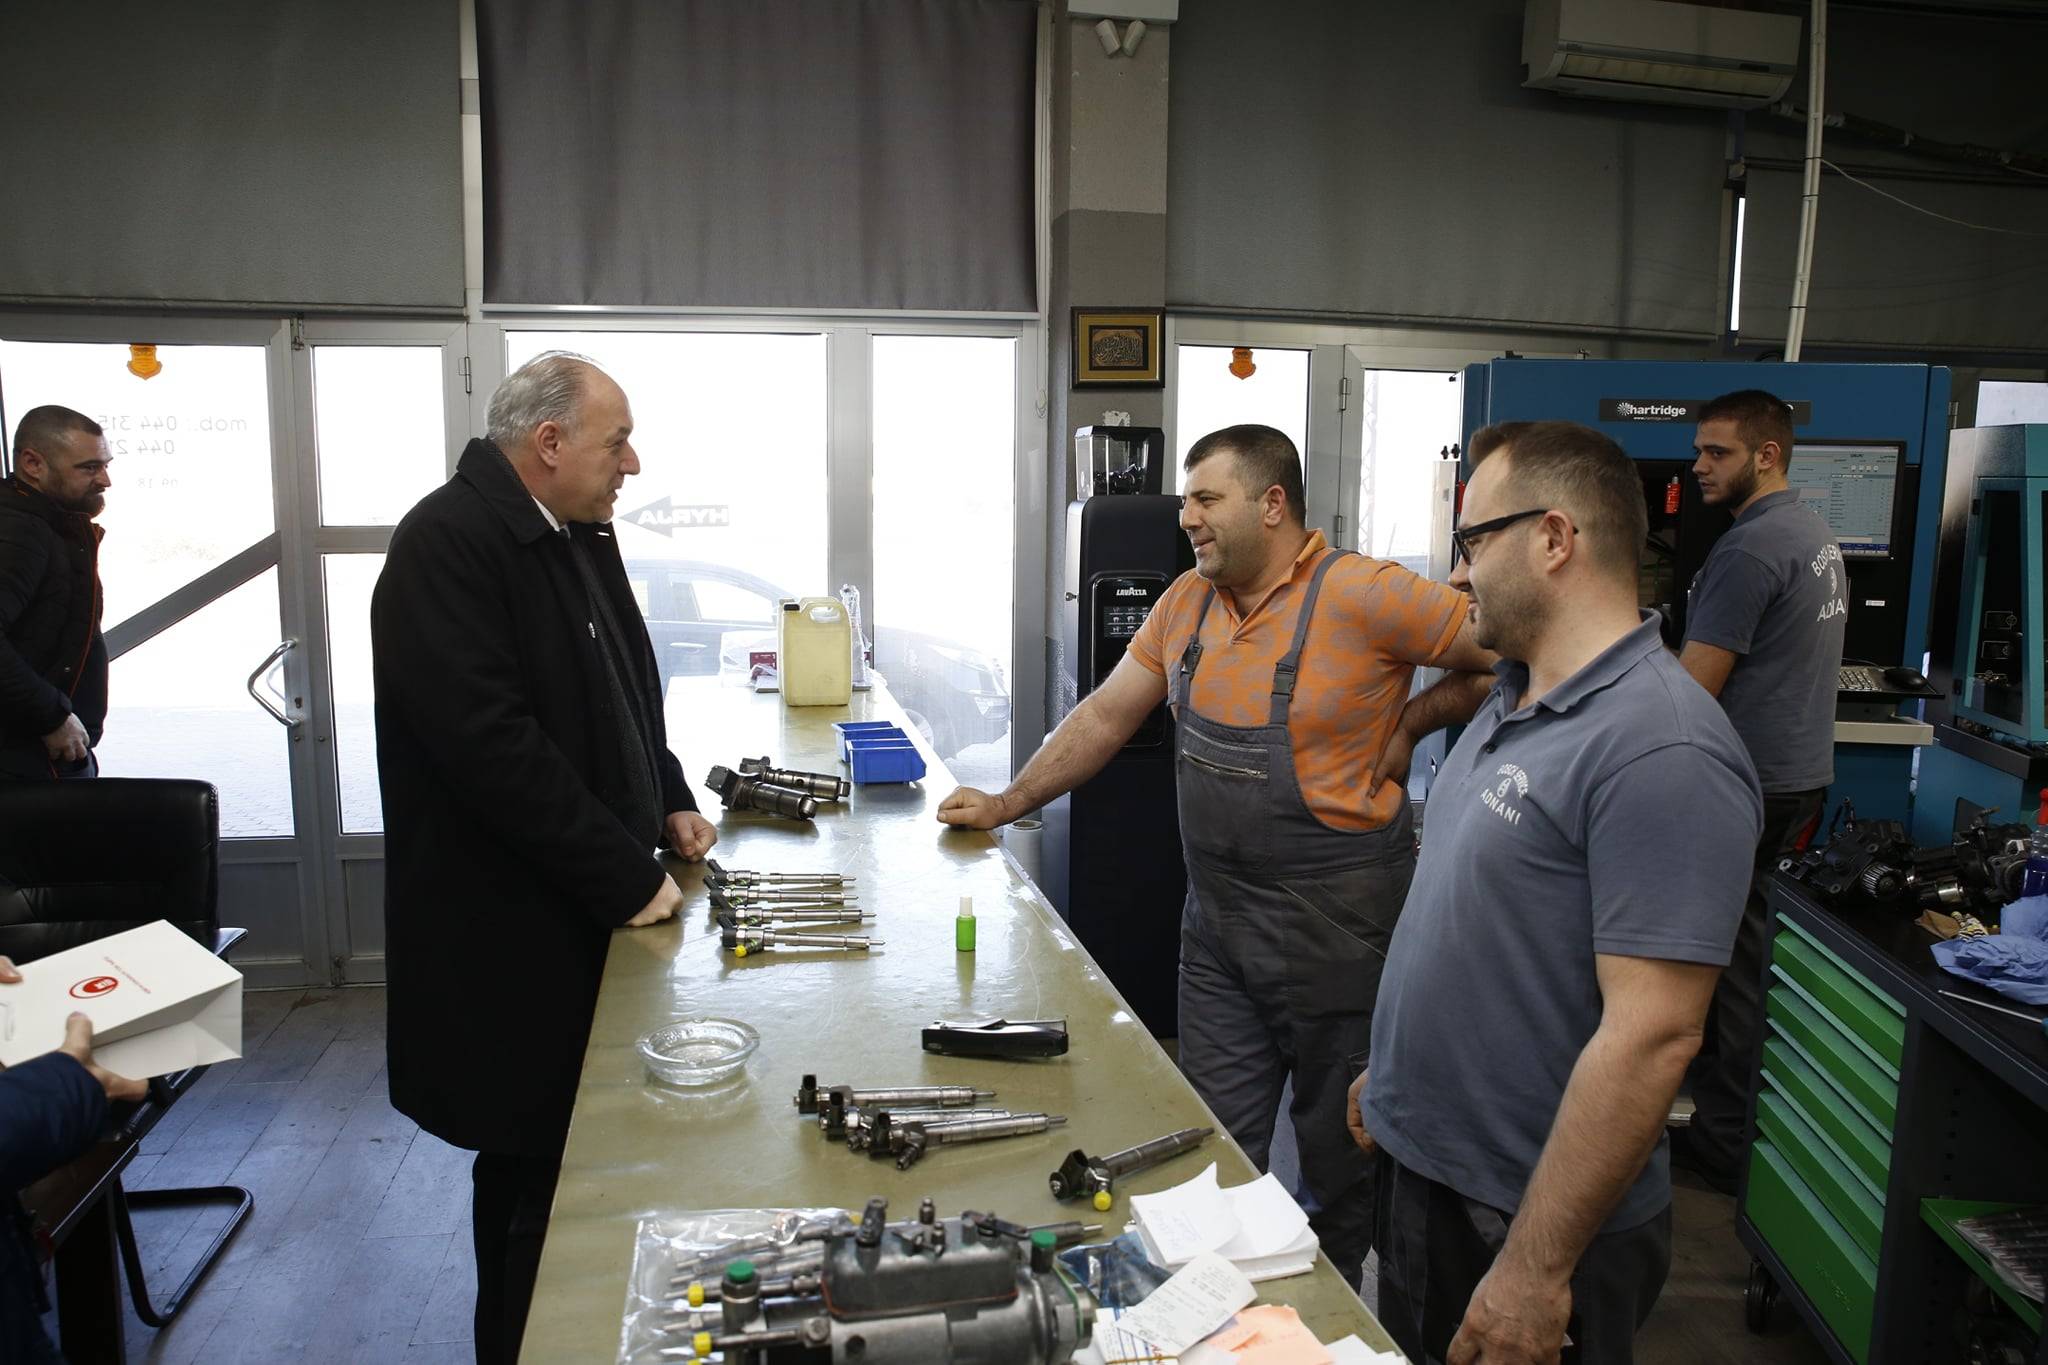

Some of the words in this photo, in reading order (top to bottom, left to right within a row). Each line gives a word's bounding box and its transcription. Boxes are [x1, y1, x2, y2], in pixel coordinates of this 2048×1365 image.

[1630, 404, 1687, 417] hartridge
[1116, 587, 1147, 596] LAVAZZA
[1480, 788, 1522, 825] ADNANI
